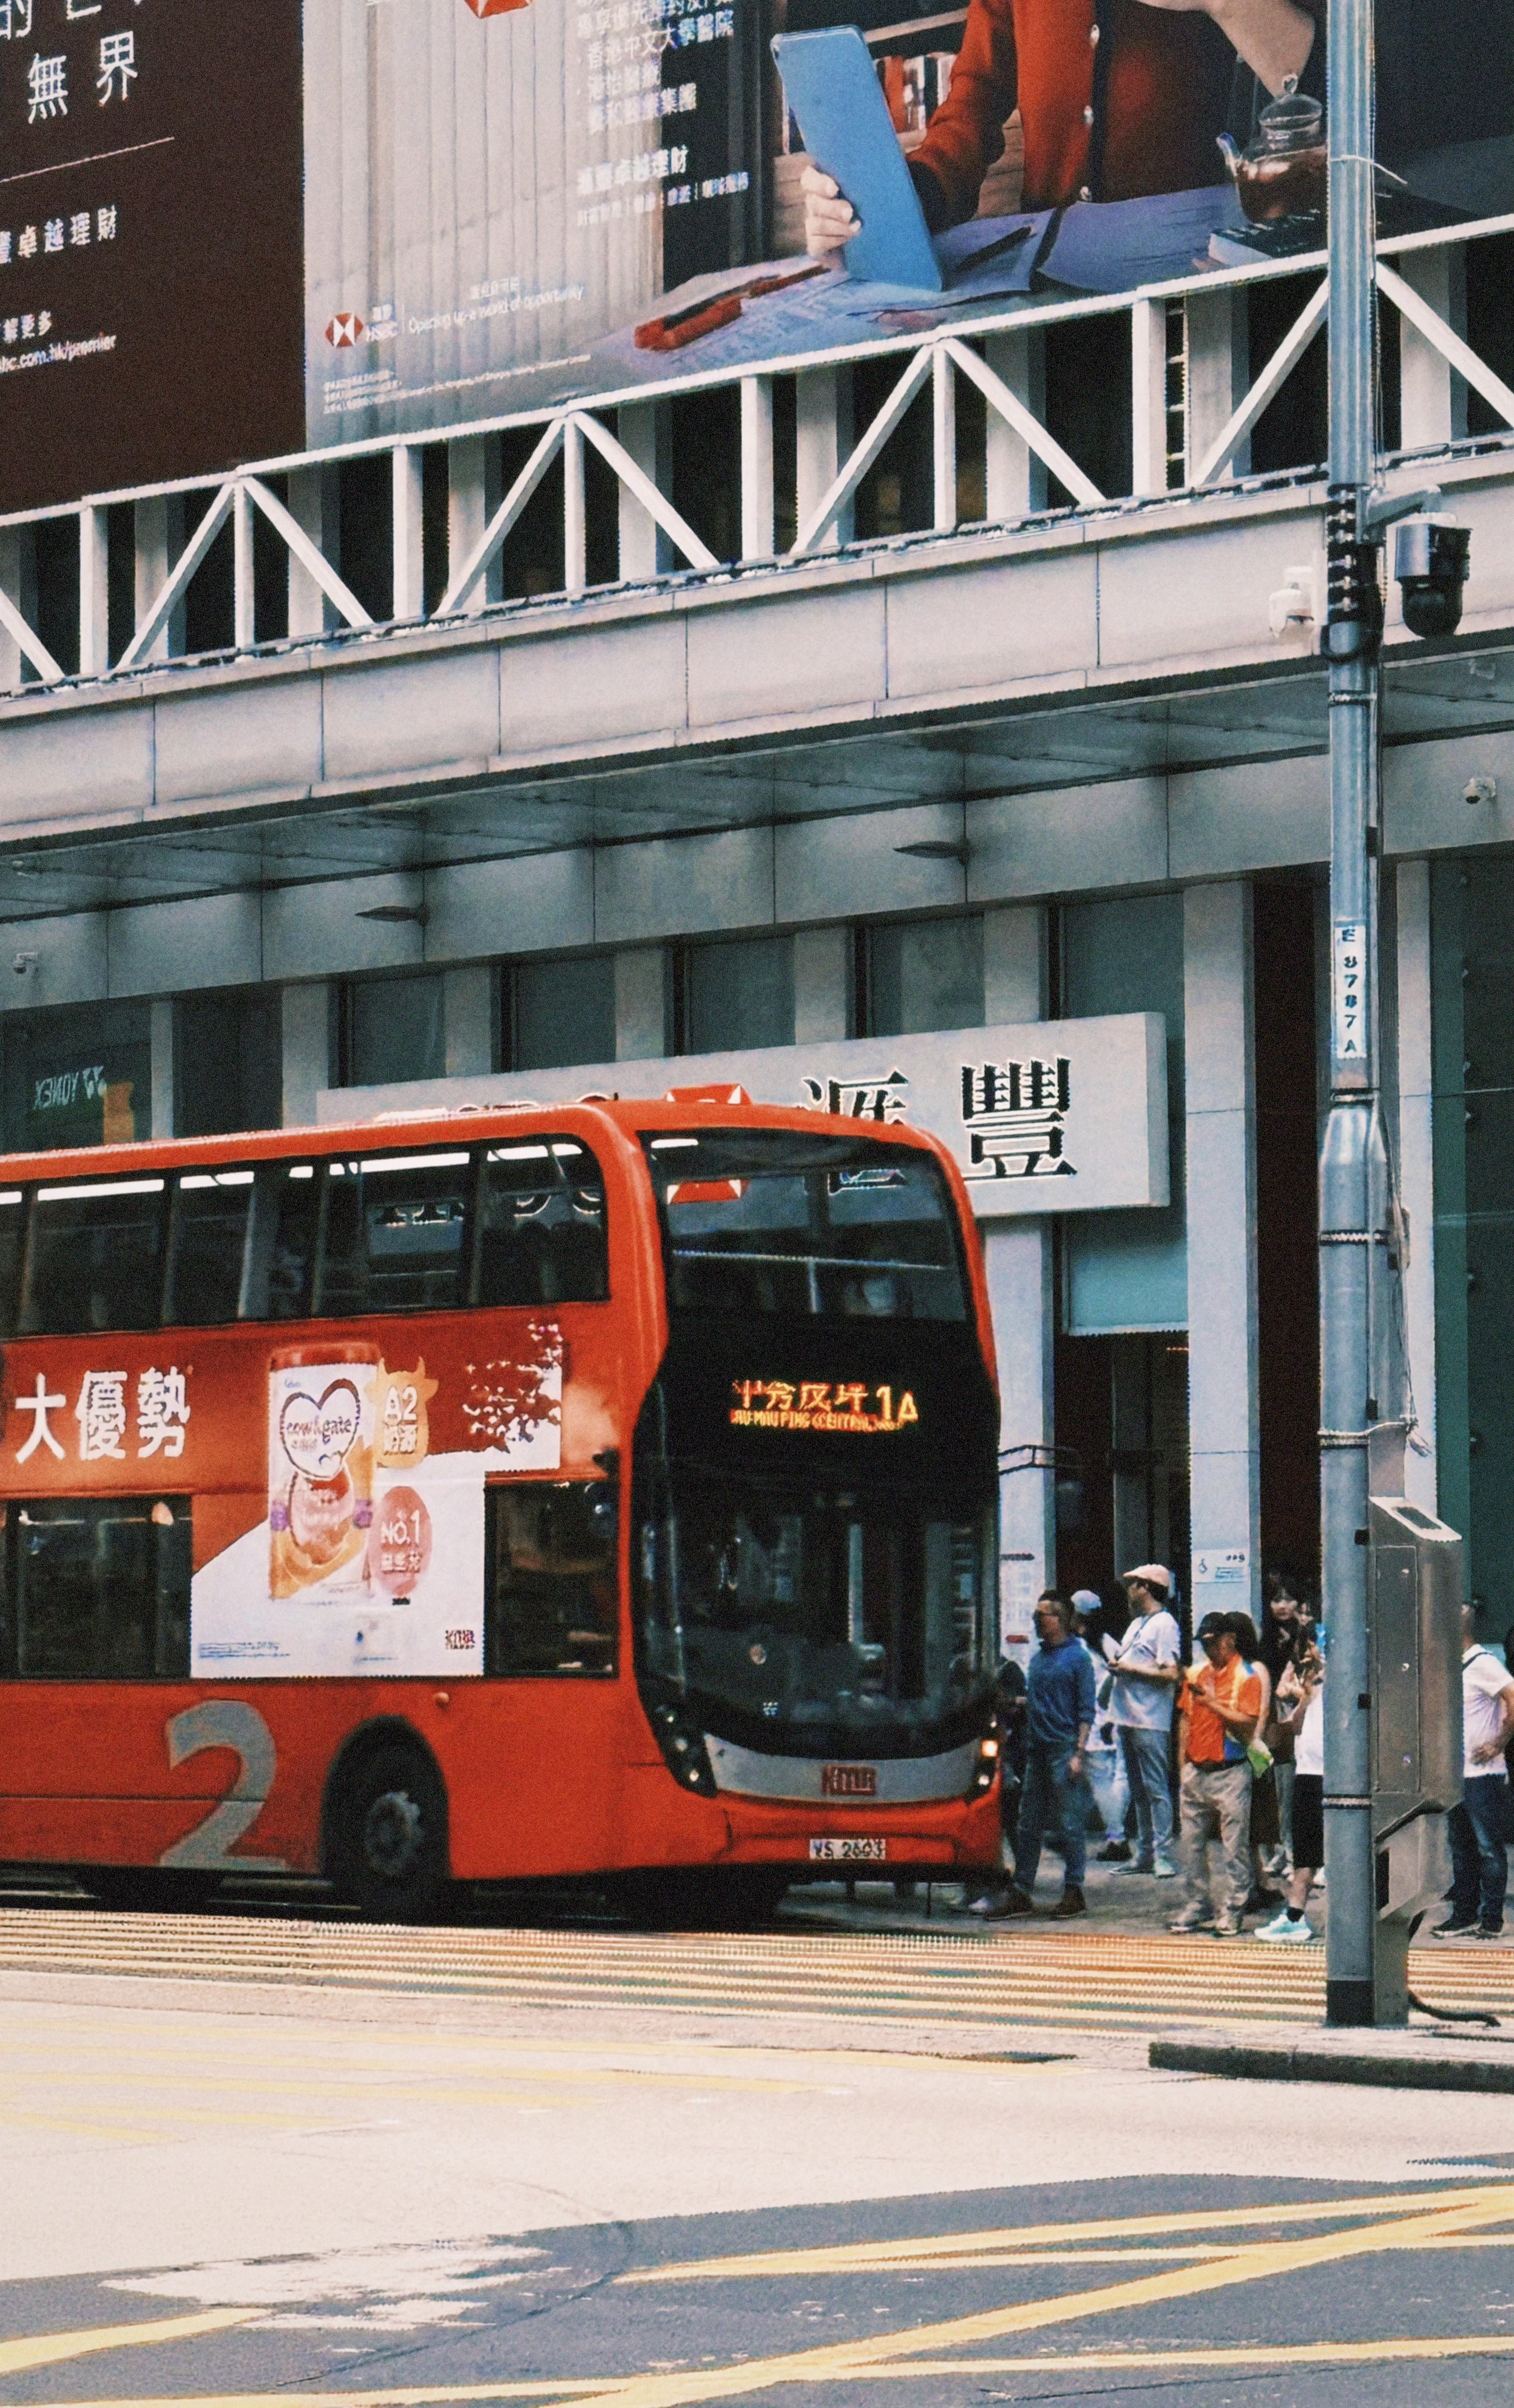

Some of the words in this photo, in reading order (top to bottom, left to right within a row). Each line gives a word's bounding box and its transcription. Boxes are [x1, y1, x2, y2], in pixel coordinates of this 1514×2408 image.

[15, 1365, 191, 1464] 大優勢
[384, 1386, 417, 1422] A2
[876, 1385, 919, 1422] 1A
